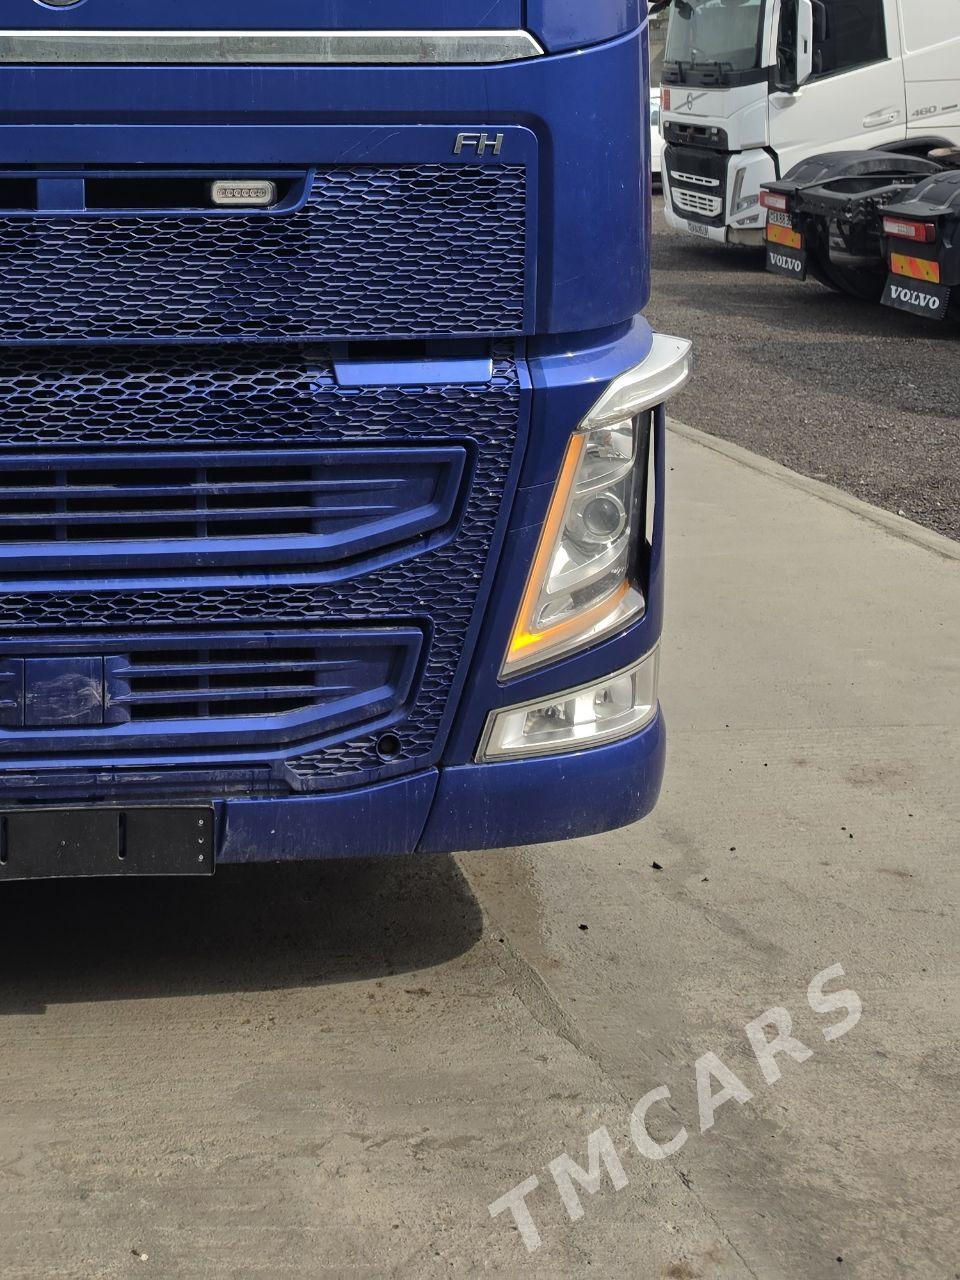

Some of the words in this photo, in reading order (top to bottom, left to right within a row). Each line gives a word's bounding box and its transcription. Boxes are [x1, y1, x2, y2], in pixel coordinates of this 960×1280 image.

[453, 132, 504, 155] FH
[769, 252, 802, 272] VOLVO
[890, 285, 940, 310] VOLVO
